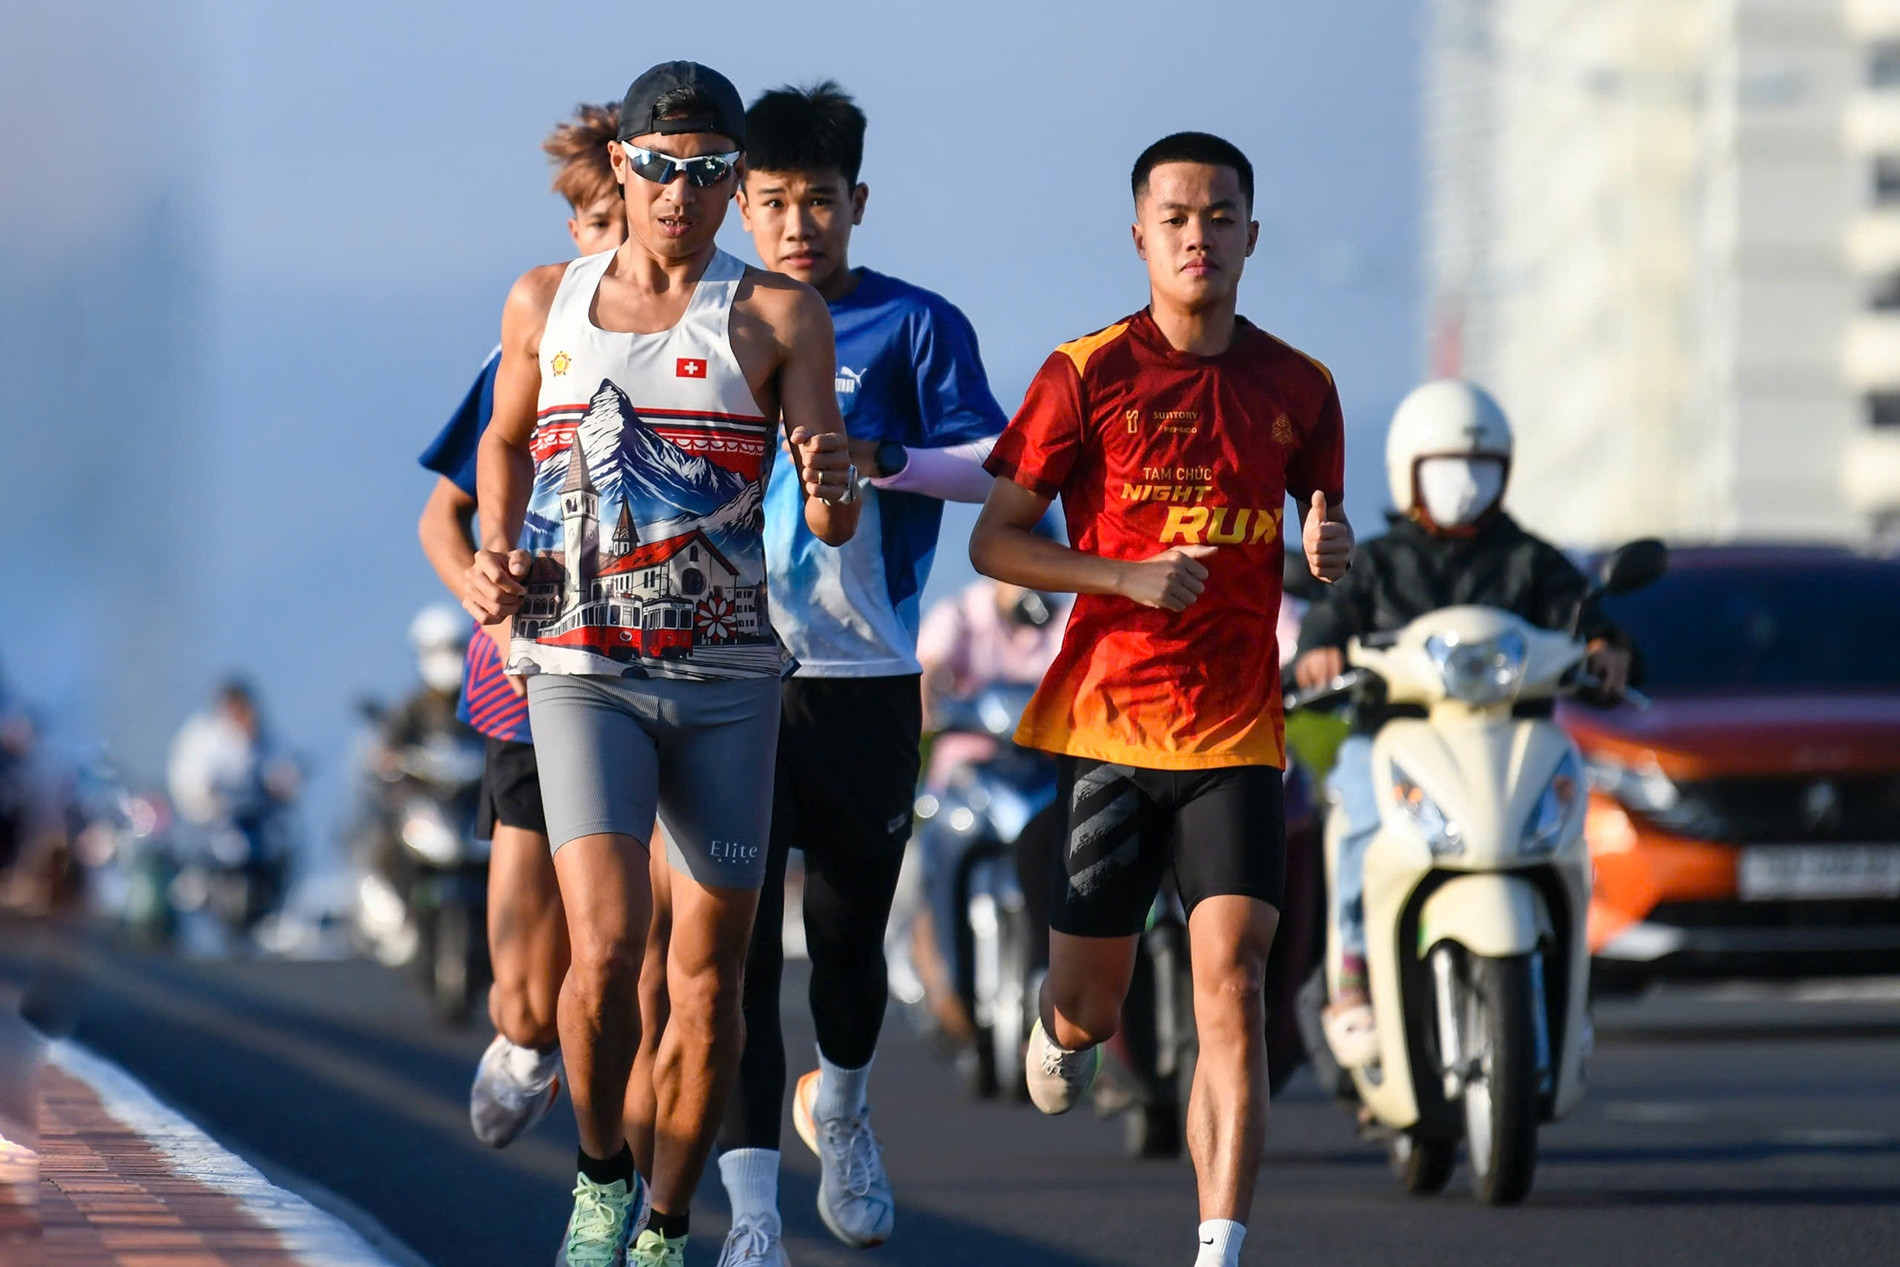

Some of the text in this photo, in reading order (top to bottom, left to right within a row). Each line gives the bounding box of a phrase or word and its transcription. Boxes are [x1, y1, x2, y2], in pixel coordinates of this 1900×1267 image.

[1153, 411, 1198, 420] SUNTORY
[1143, 465, 1213, 481] TAM CHÚC
[1121, 483, 1213, 503] NIGHT
[1159, 505, 1283, 545] RUN
[710, 840, 759, 859] Elite
